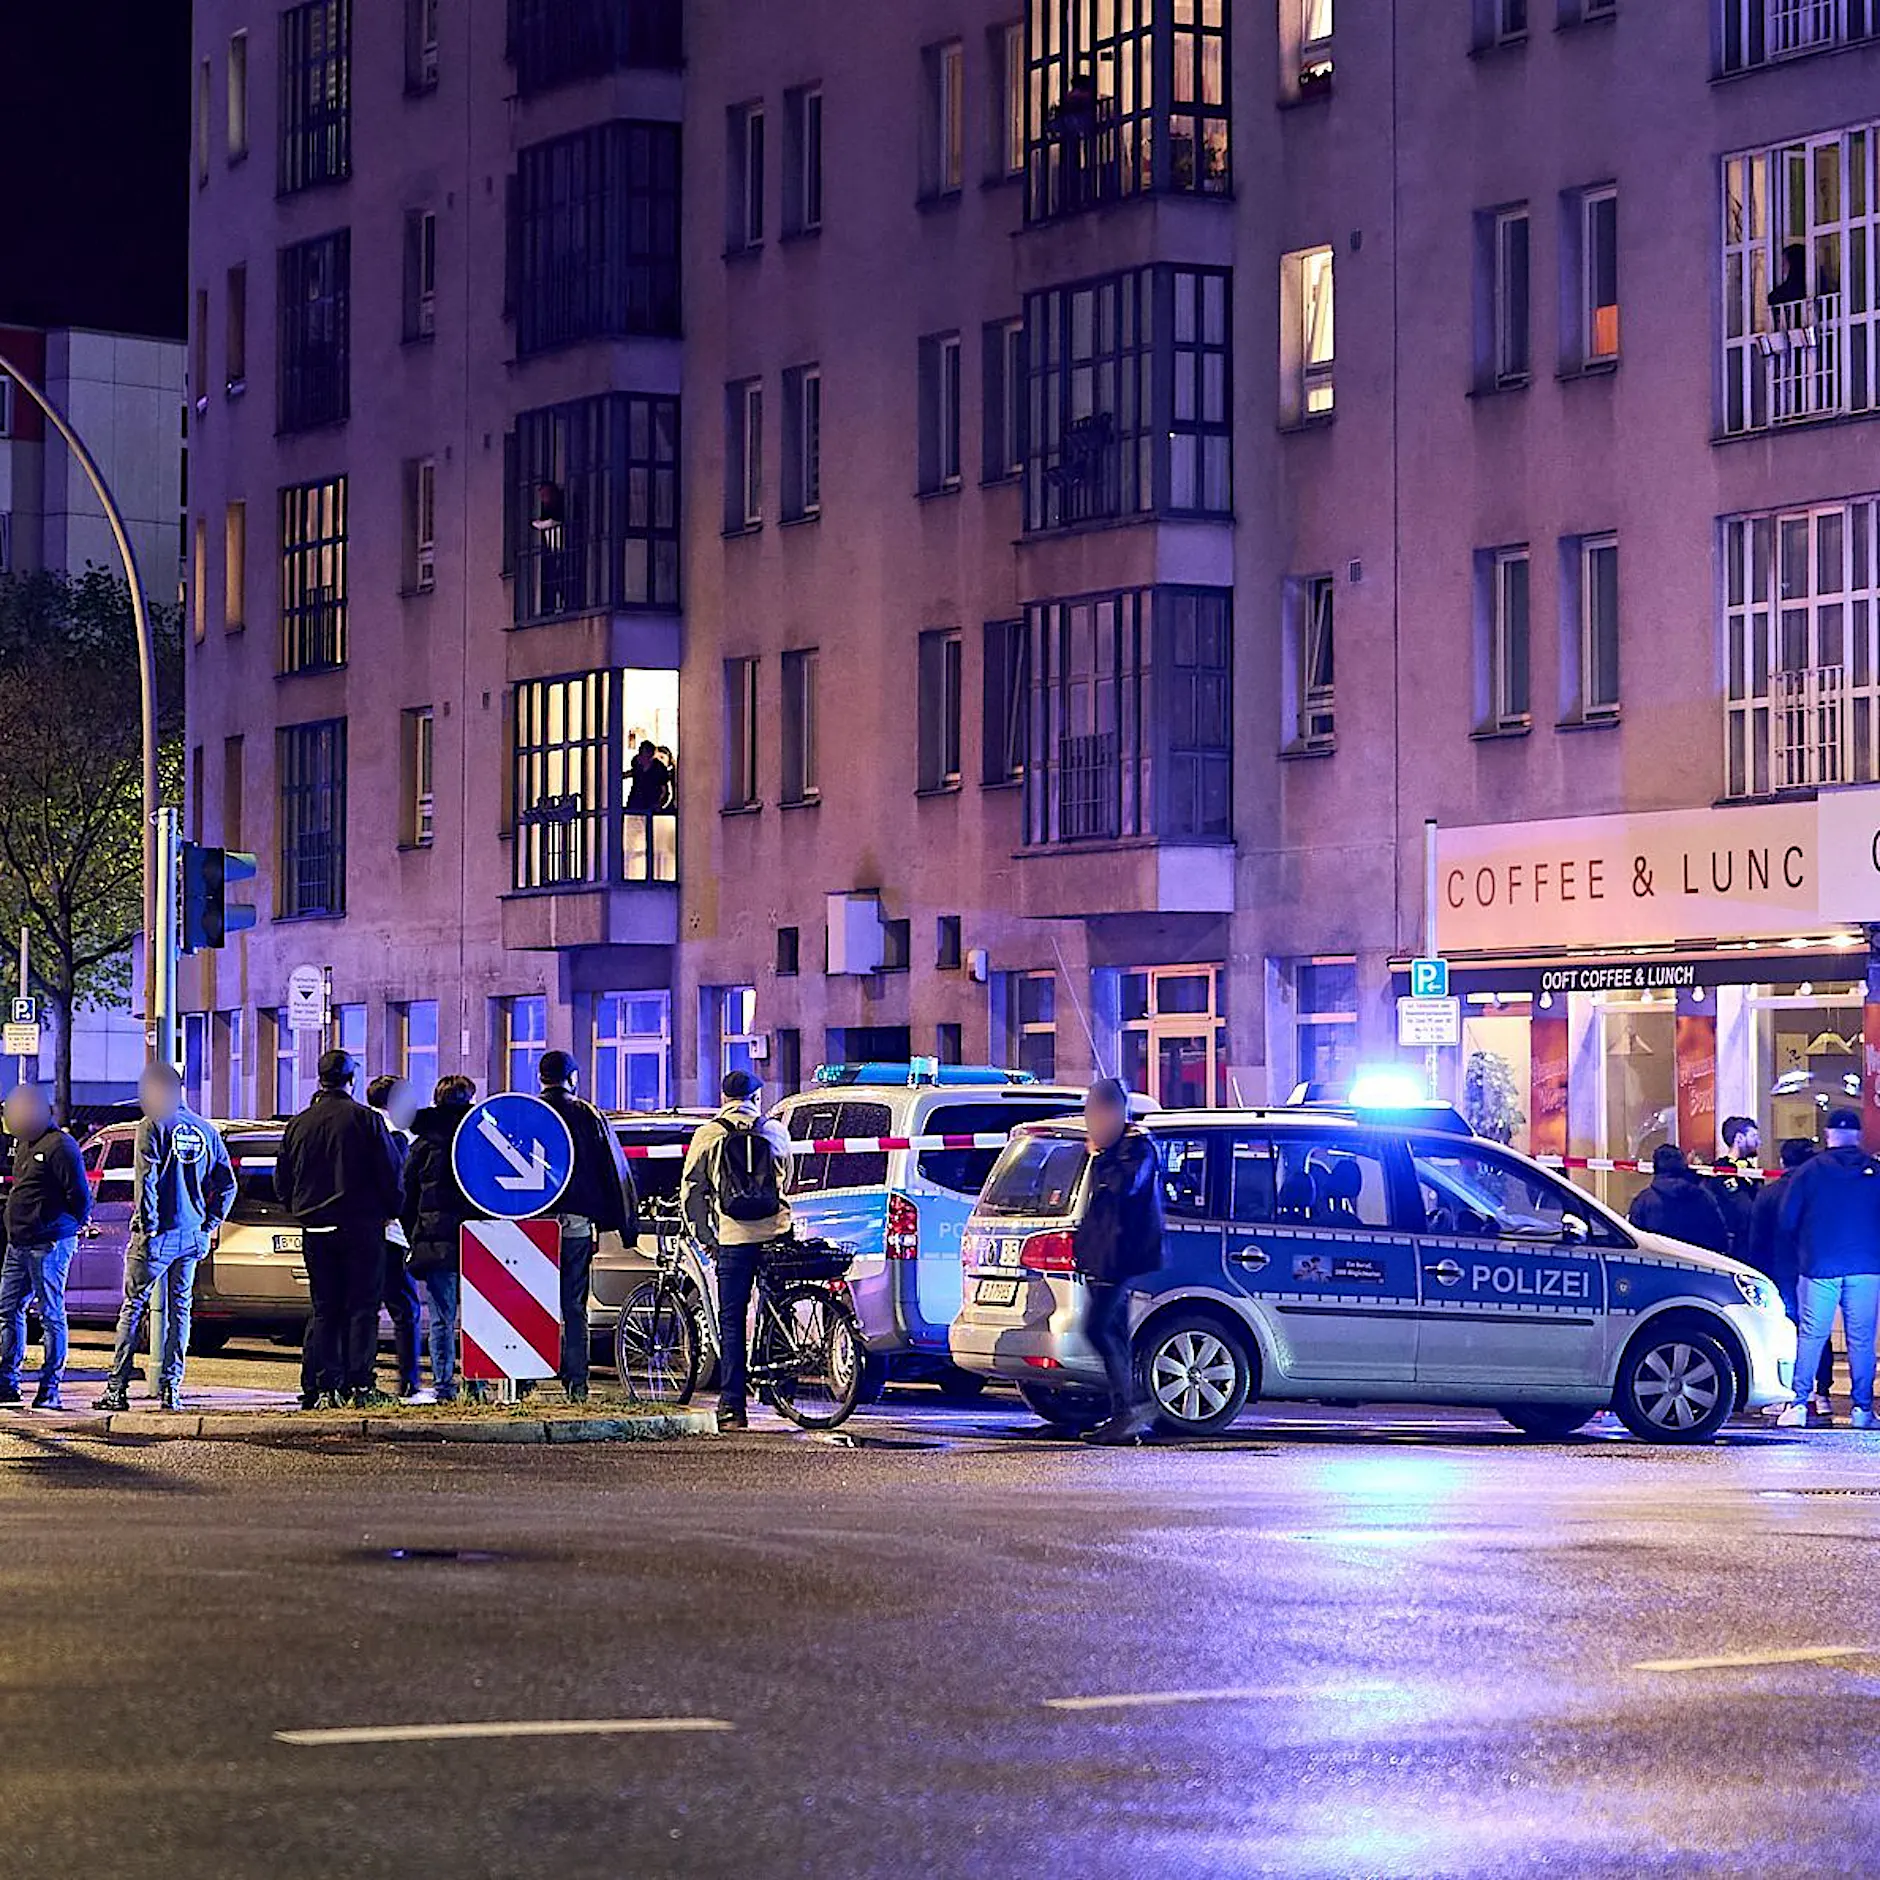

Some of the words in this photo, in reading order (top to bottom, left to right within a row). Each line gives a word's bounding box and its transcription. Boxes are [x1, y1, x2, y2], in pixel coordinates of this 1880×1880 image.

[1447, 859, 1605, 909] COFFEE
[1632, 855, 1655, 898] &
[1683, 845, 1804, 895] LUNC
[1417, 963, 1438, 993] P
[1541, 970, 1577, 990] OOFT
[1580, 968, 1633, 989] COFFEE
[1634, 967, 1645, 986] &
[1648, 965, 1695, 986] LUNCH
[15, 1000, 29, 1020] P
[1472, 1264, 1589, 1298] POLIZEI
